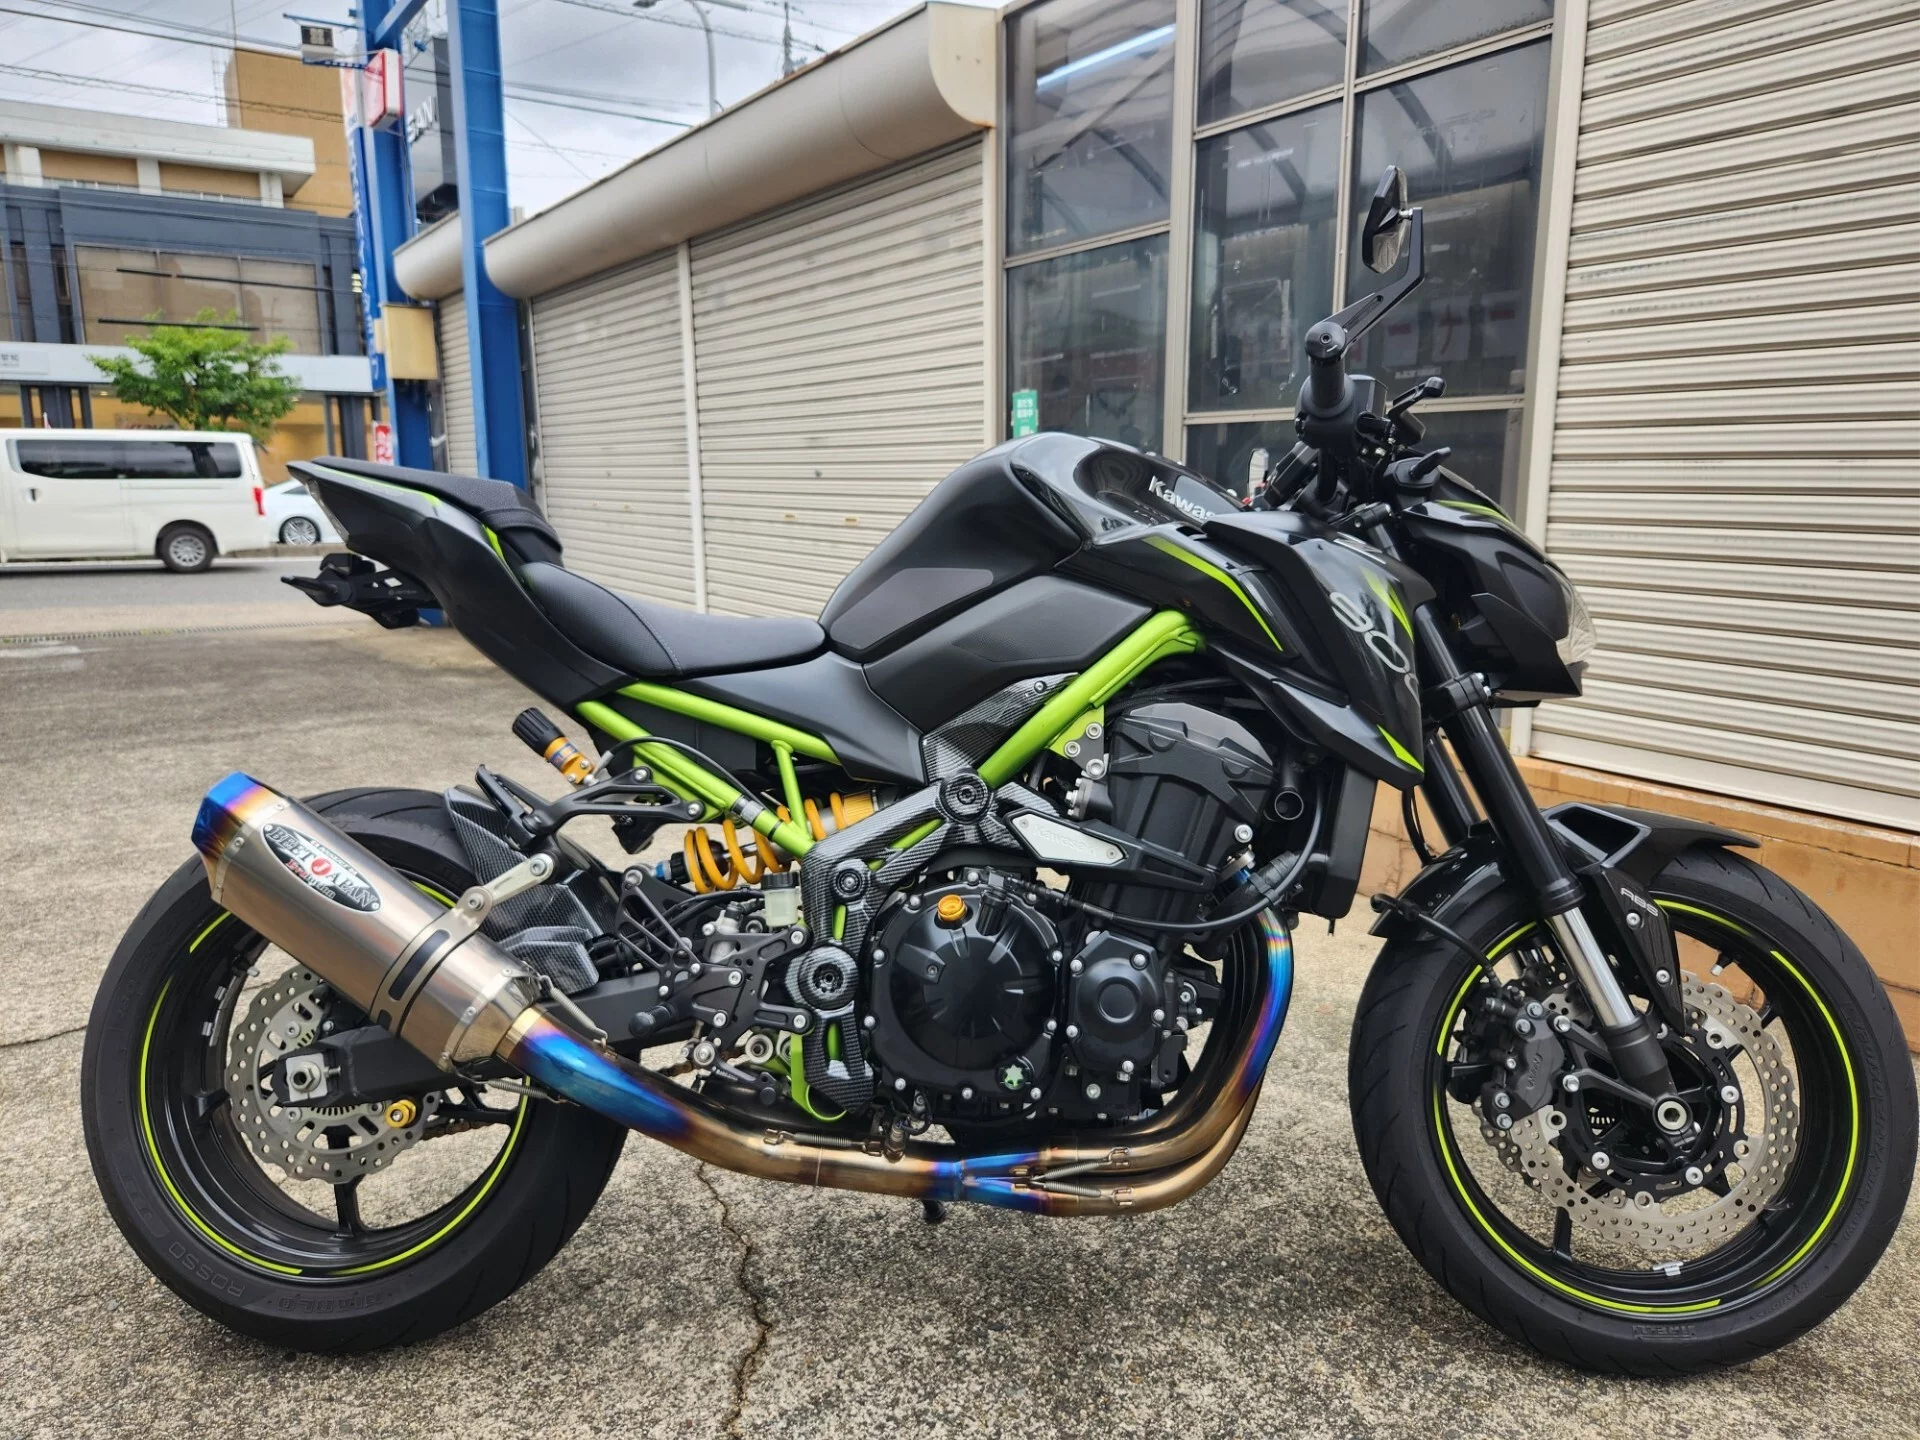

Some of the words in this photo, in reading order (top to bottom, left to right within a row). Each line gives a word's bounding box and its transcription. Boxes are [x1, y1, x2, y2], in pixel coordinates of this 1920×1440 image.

[266, 826, 315, 863] BEET
[313, 858, 378, 909] JAPAN
[1620, 886, 1660, 917] ABS
[169, 1242, 246, 1297] ROSSO
